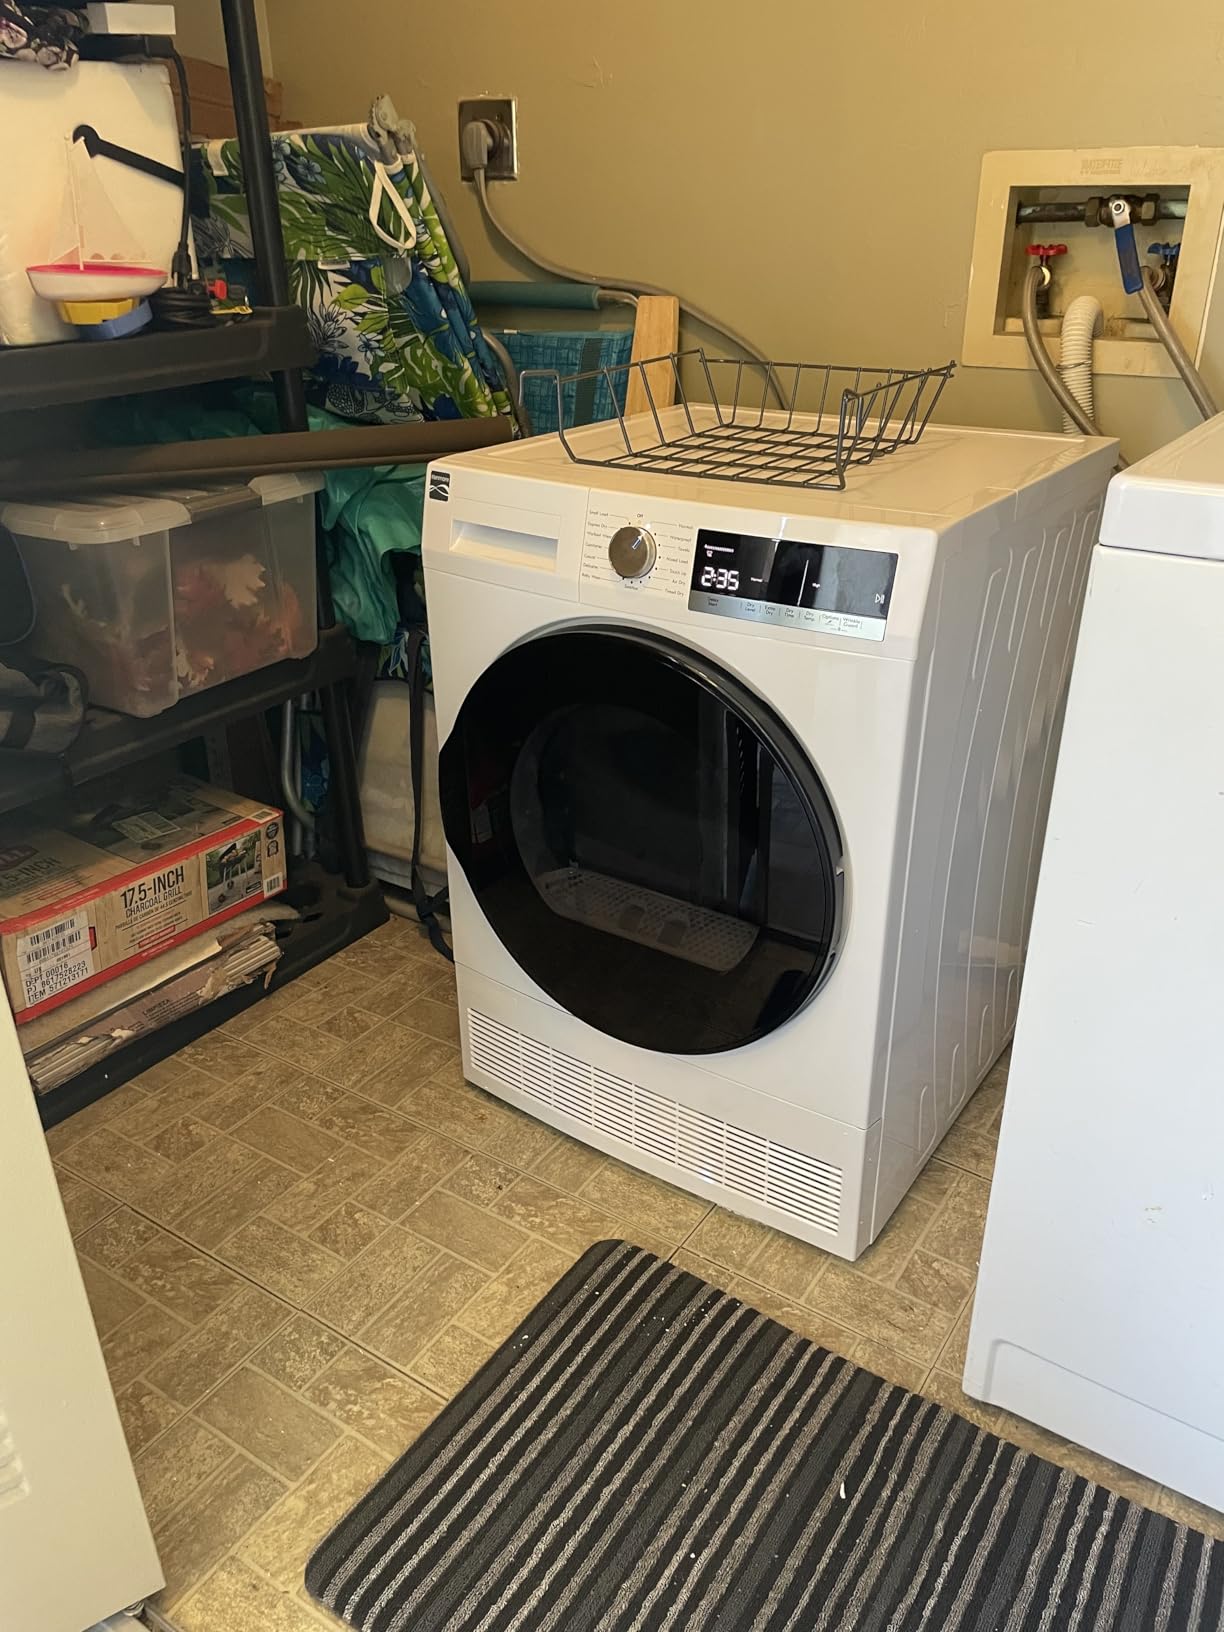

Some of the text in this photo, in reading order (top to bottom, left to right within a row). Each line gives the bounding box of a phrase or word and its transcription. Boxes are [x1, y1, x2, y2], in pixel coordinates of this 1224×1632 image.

[701, 566, 740, 590] 2:35
[120, 866, 184, 908] 17.5-INCH
[126, 897, 162, 918] CHARCOAL
[164, 886, 182, 900] GRILL
